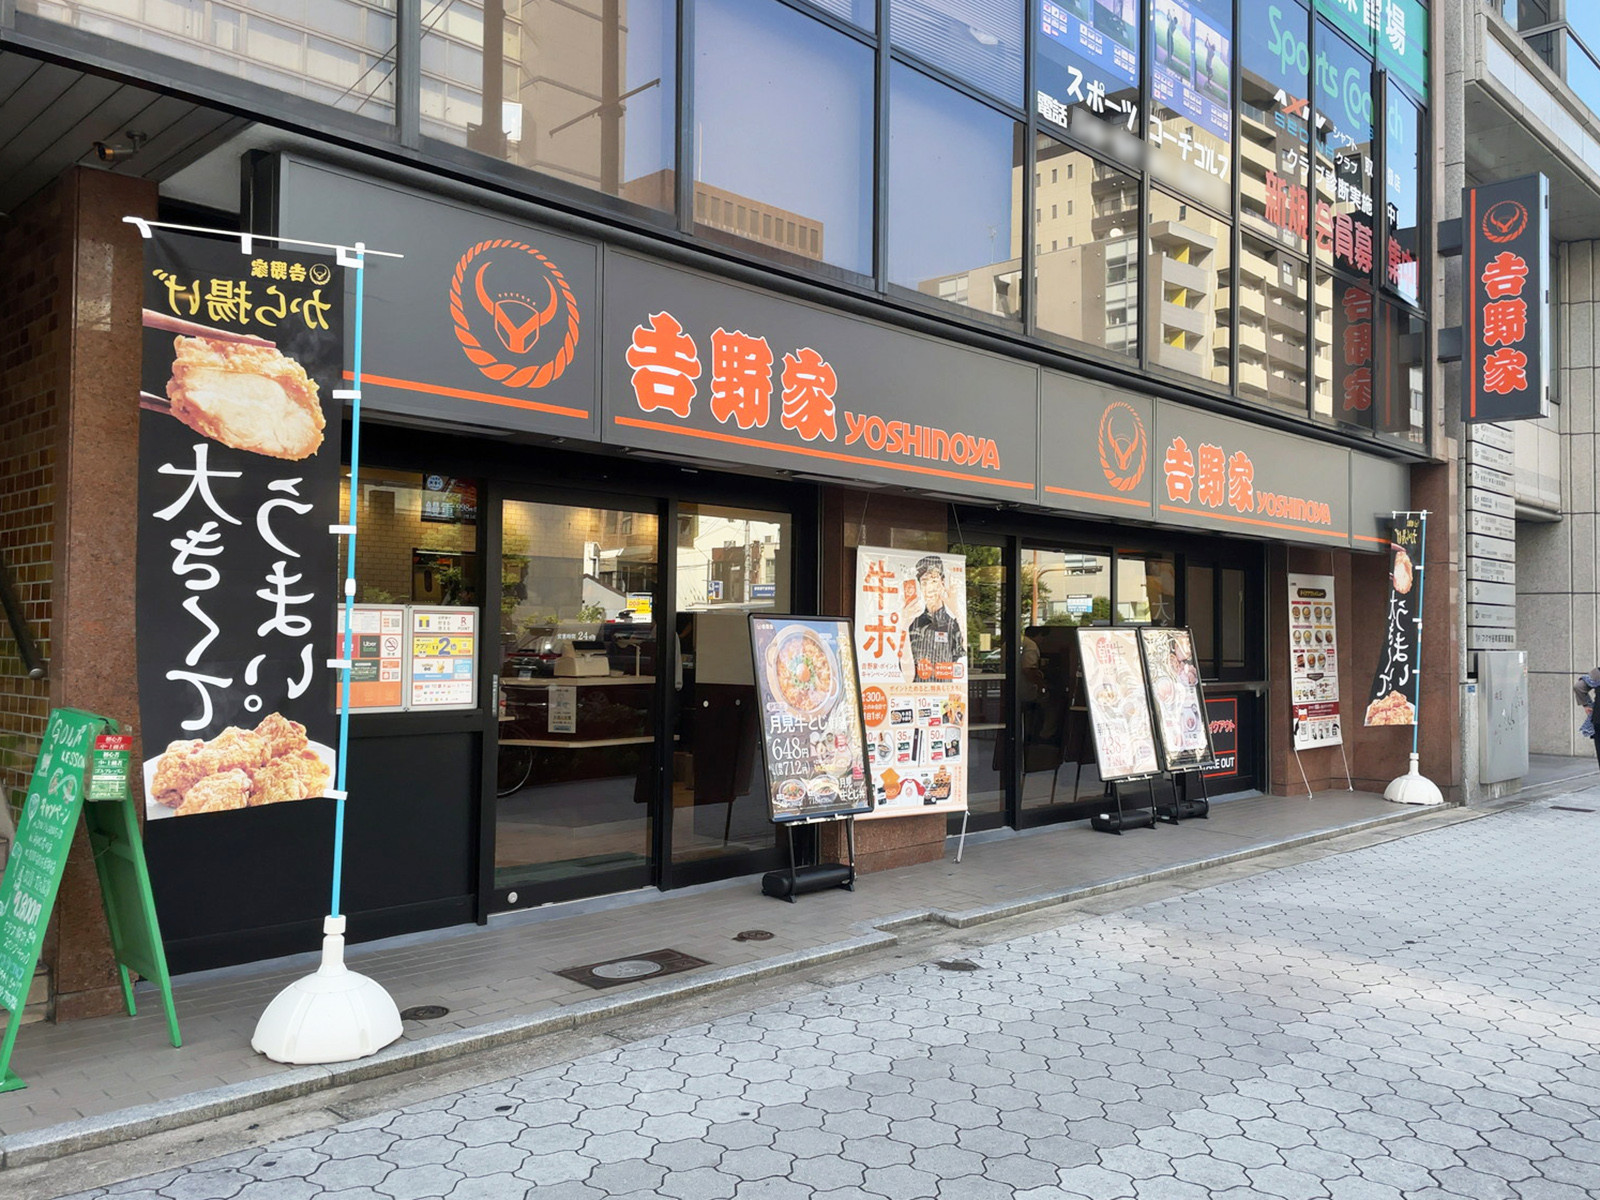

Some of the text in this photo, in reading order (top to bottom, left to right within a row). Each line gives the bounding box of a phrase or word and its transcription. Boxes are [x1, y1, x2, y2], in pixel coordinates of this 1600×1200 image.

[1037, 90, 1067, 128] 電話
[1333, 126, 1358, 151] シャフト
[1336, 152, 1359, 175] クラブ
[1482, 251, 1529, 395] 吉野家
[625, 310, 1001, 470] 吉野家 YOSHINOYA
[1164, 436, 1331, 525] 吉野家 YOSHINOYA
[772, 736, 810, 761] 648円
[1220, 756, 1235, 769] OUT
